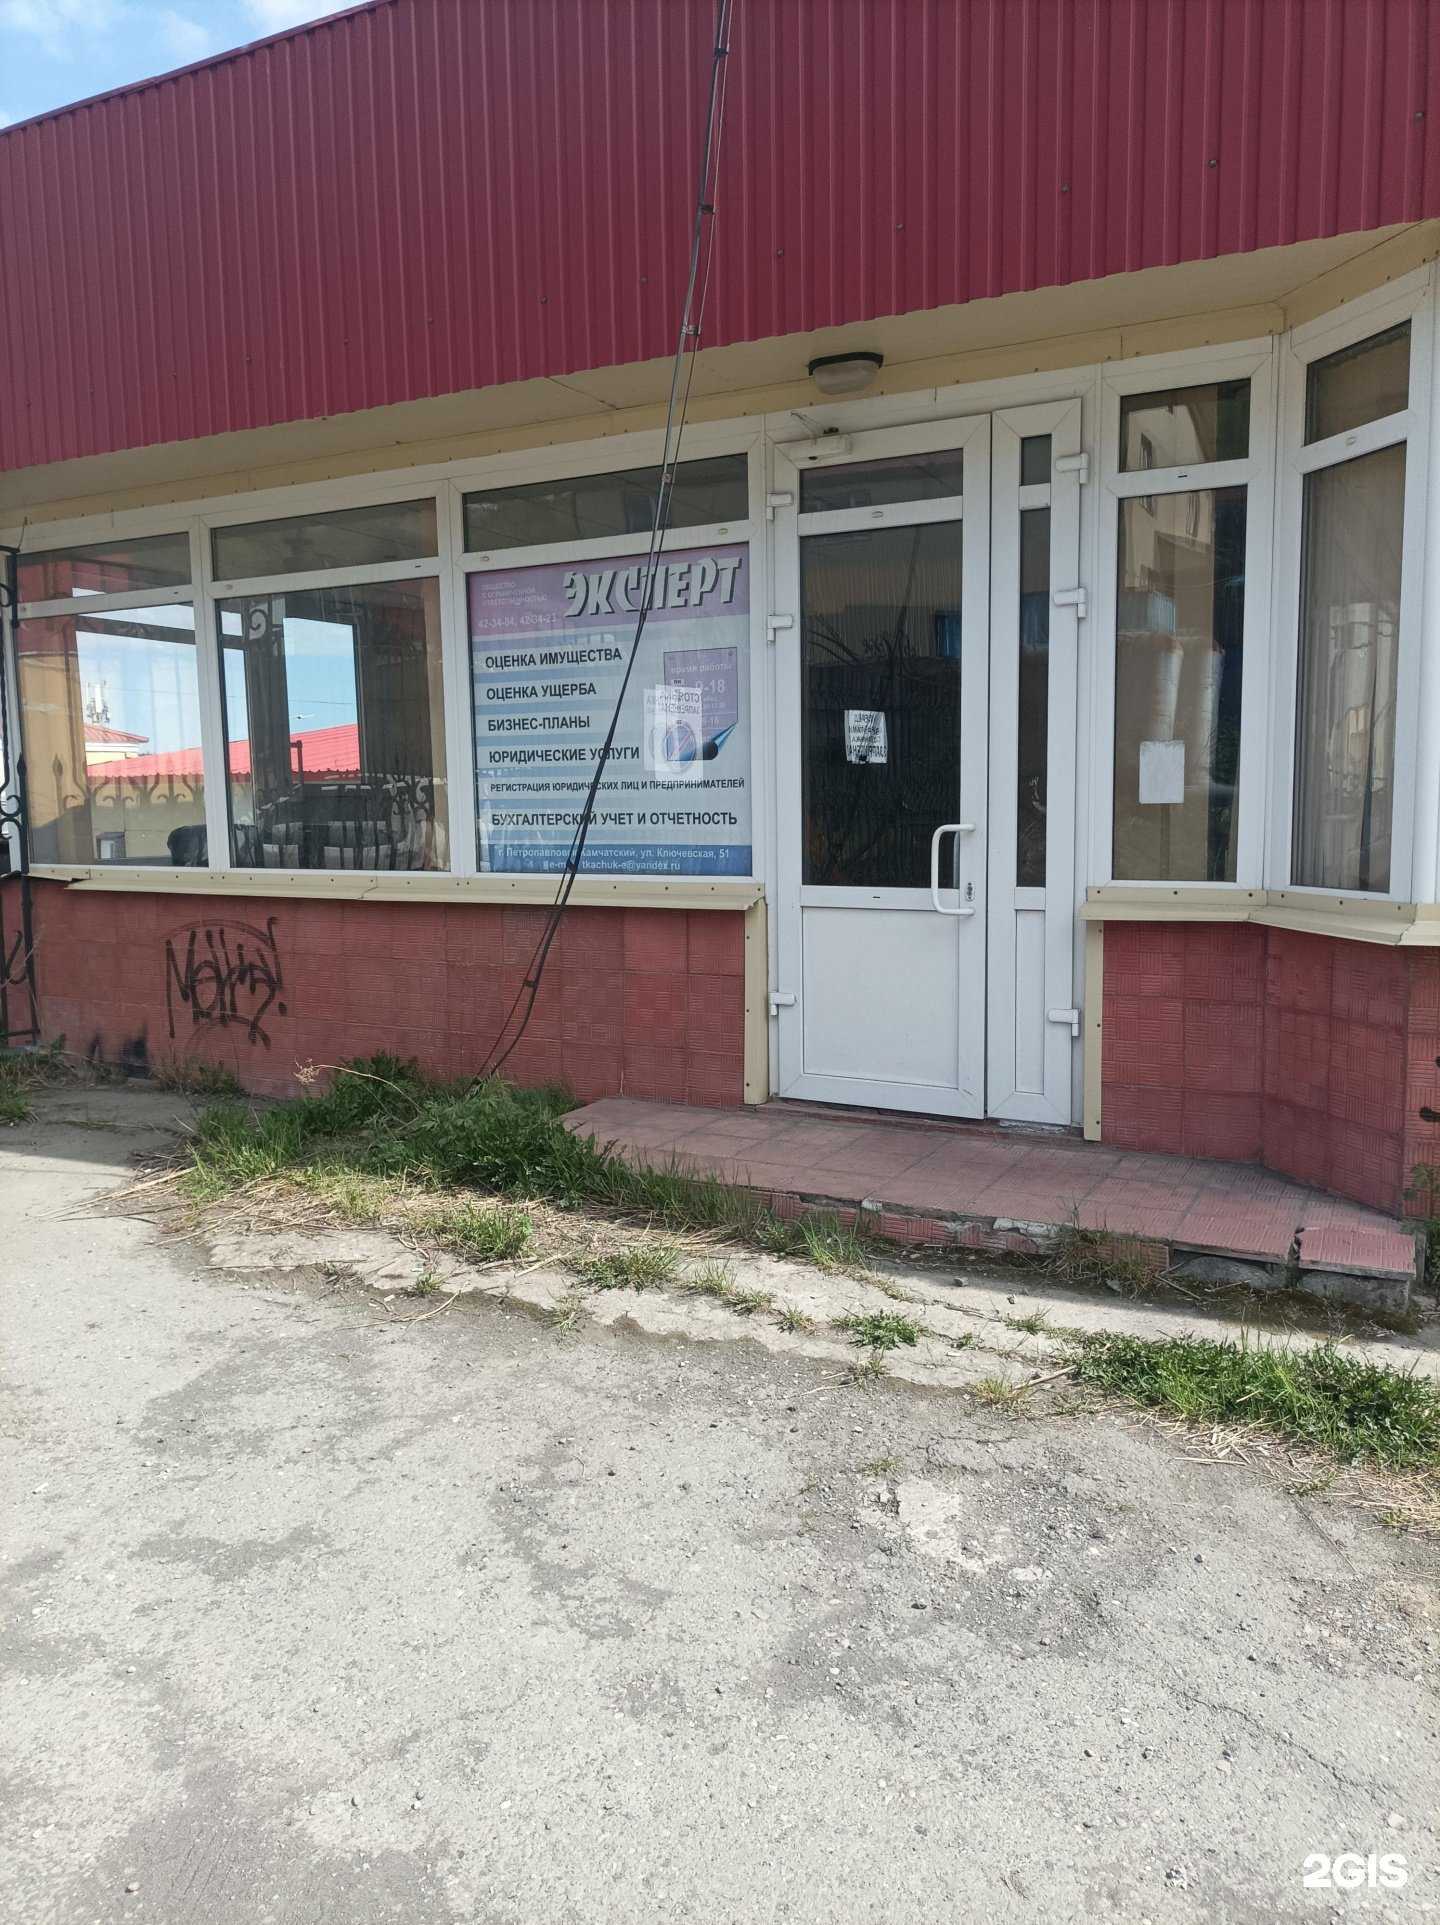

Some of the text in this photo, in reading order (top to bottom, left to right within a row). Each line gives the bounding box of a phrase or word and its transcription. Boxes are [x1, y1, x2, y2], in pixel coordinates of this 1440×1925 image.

[563, 556, 743, 618] ЭКСПЕРТ
[485, 647, 623, 670] ОЦЕНКА ИМУЩЕСТВА
[486, 682, 597, 701] ОЦЕНКА УЩЕРБА
[488, 715, 591, 732] БИЗНЕС-ПЛАНЫ
[489, 746, 640, 764] ЮРИДИЧЕСКИЕ УСЛУГИ
[490, 777, 745, 793] РЕГИСТРАЦИЯ ЮРИДИЧСКИХ ЛИЦ И ПРЕДПРИНИМАТЕЛЕЙ
[600, 812, 634, 825] УЧЕТ
[637, 812, 647, 825] И
[649, 812, 738, 825] ОТЧЕТНОСТЬ
